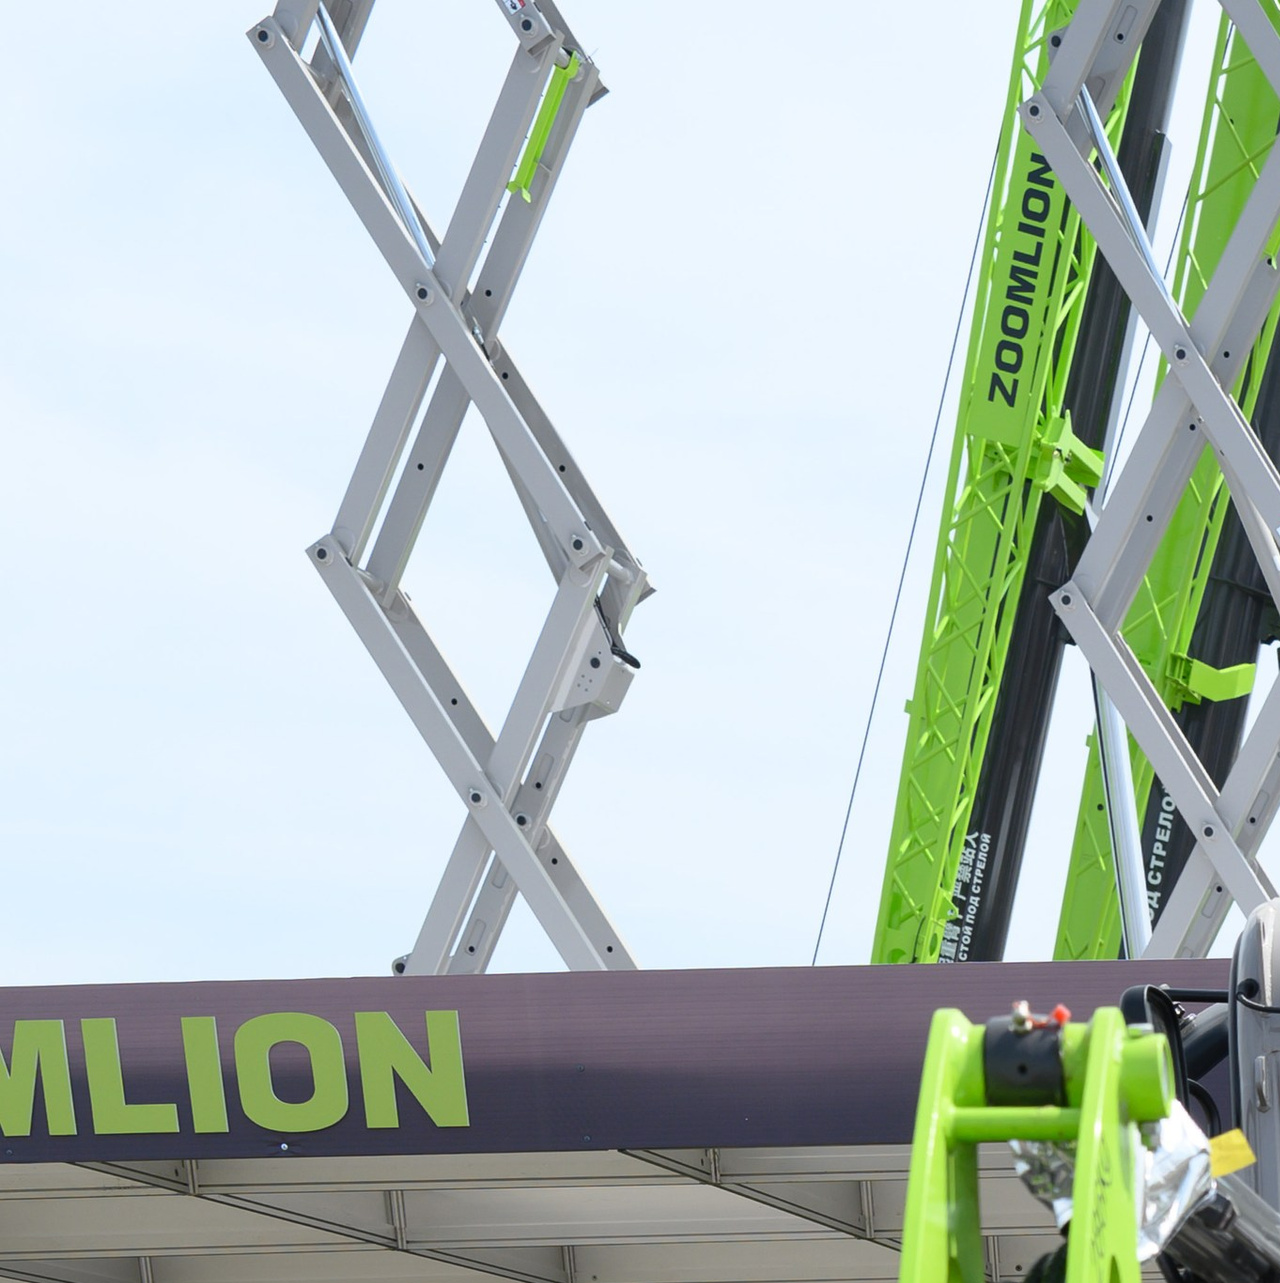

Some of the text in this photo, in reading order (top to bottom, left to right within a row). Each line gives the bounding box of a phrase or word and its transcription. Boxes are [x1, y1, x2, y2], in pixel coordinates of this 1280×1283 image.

[988, 152, 1054, 407] ZOOMLION
[959, 833, 992, 961] СТОЙ ПОД СТРЕЛОЙ
[1148, 788, 1177, 885] СТРЕЛО
[0, 1010, 470, 1136] MLION
